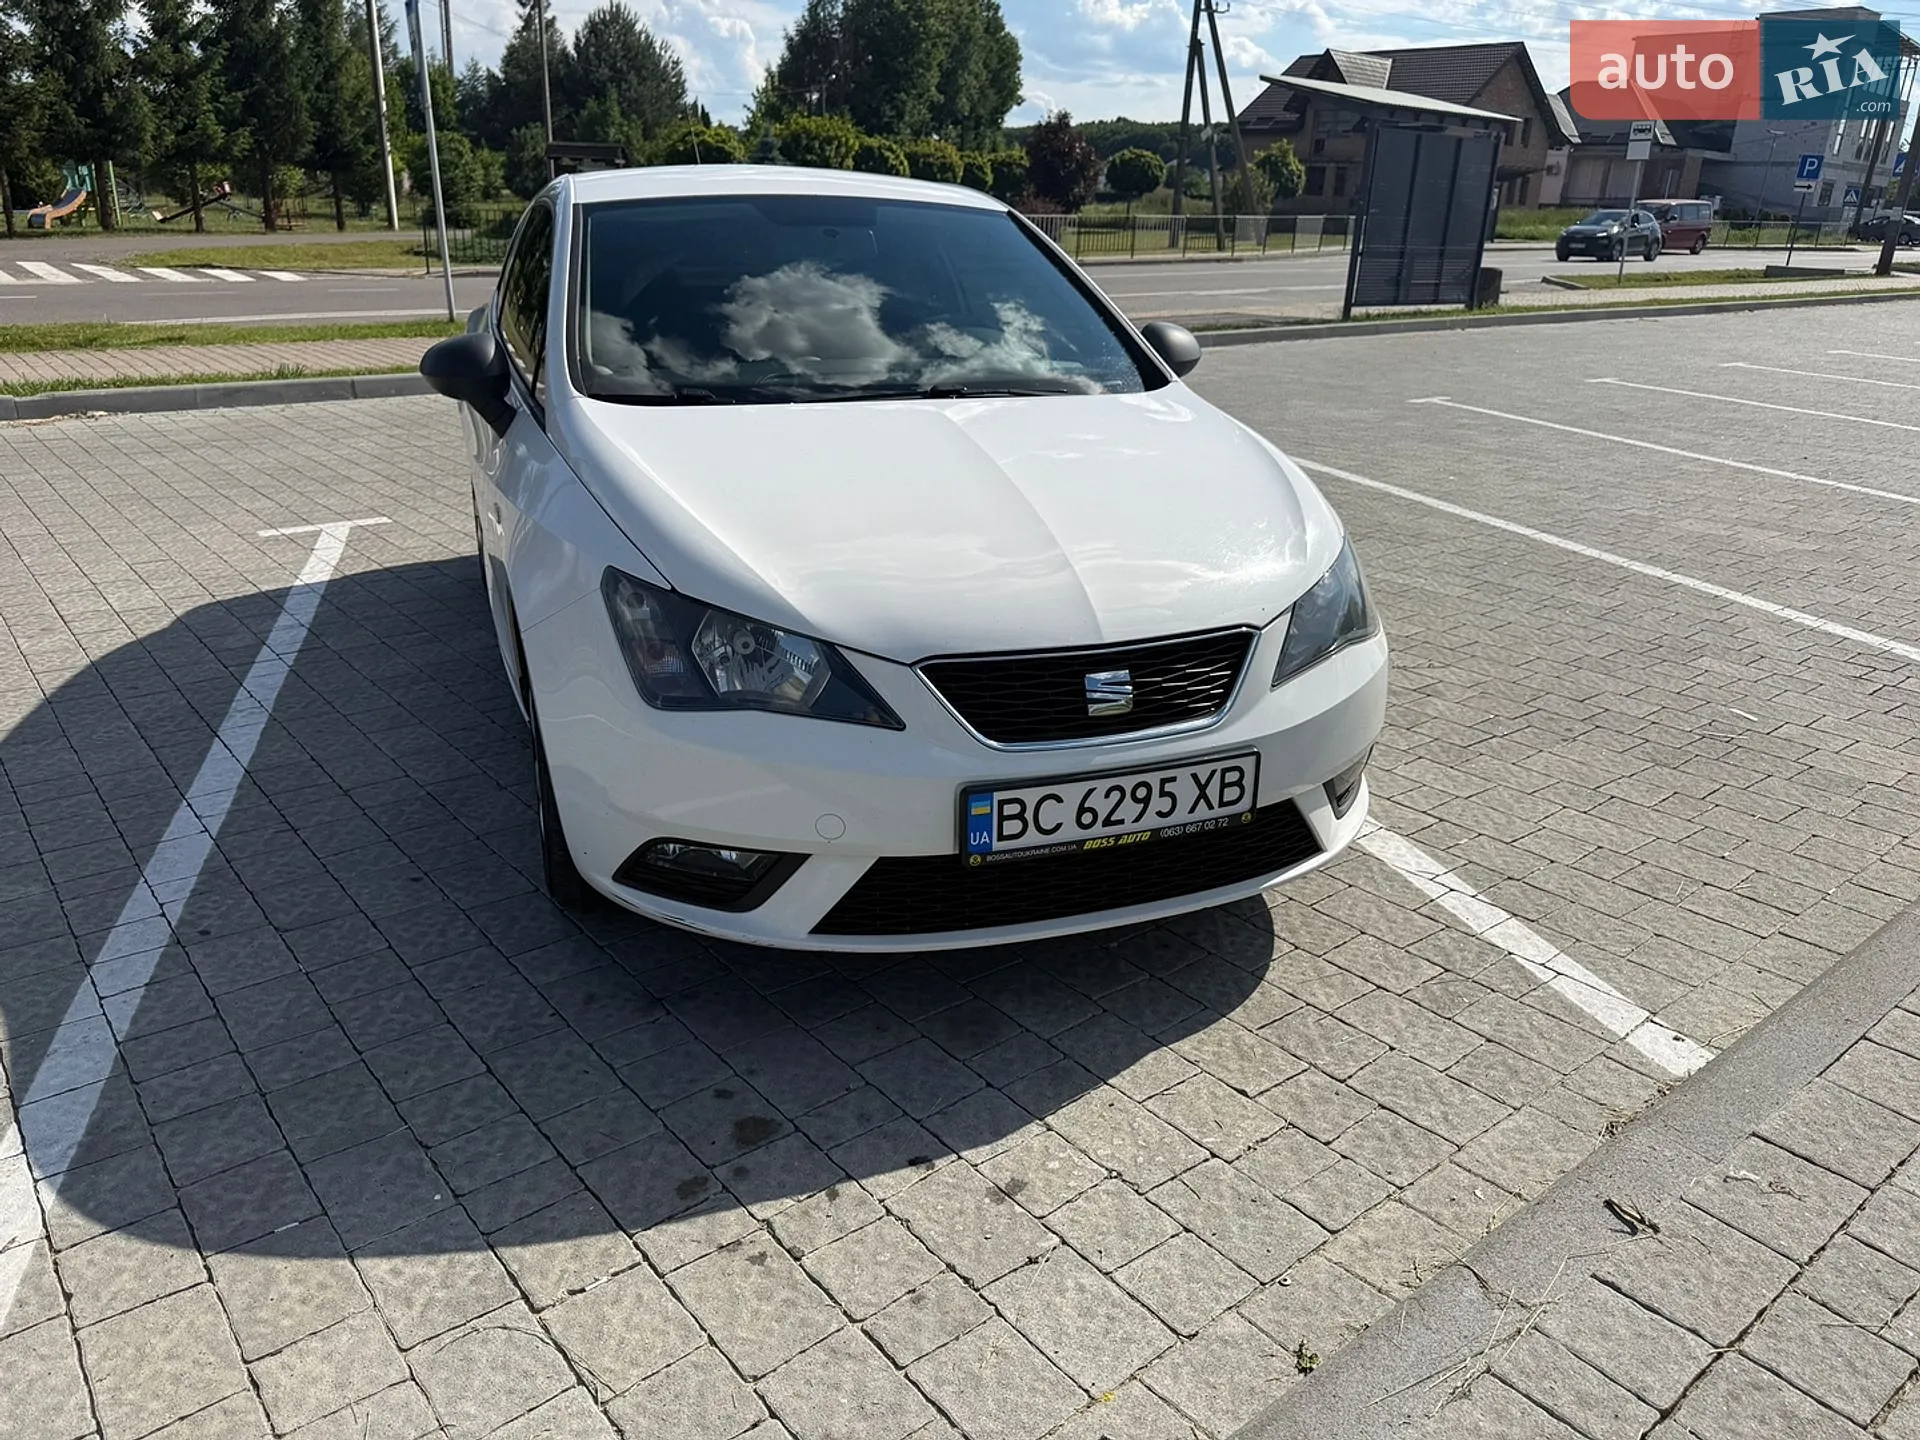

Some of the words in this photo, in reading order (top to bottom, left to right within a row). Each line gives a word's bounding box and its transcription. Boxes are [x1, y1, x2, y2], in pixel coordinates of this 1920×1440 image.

[1802, 157, 1819, 177] P
[996, 793, 1065, 843] BC
[1075, 775, 1178, 831] 6295
[1187, 765, 1246, 815] XB
[1160, 826, 1183, 838] (063)
[1185, 822, 1203, 834] 667
[1204, 819, 1216, 830] 02
[1217, 817, 1230, 828] 72
[970, 831, 990, 845] UA
[1083, 837, 1116, 850] BOSS
[1118, 831, 1152, 845] AUTO
